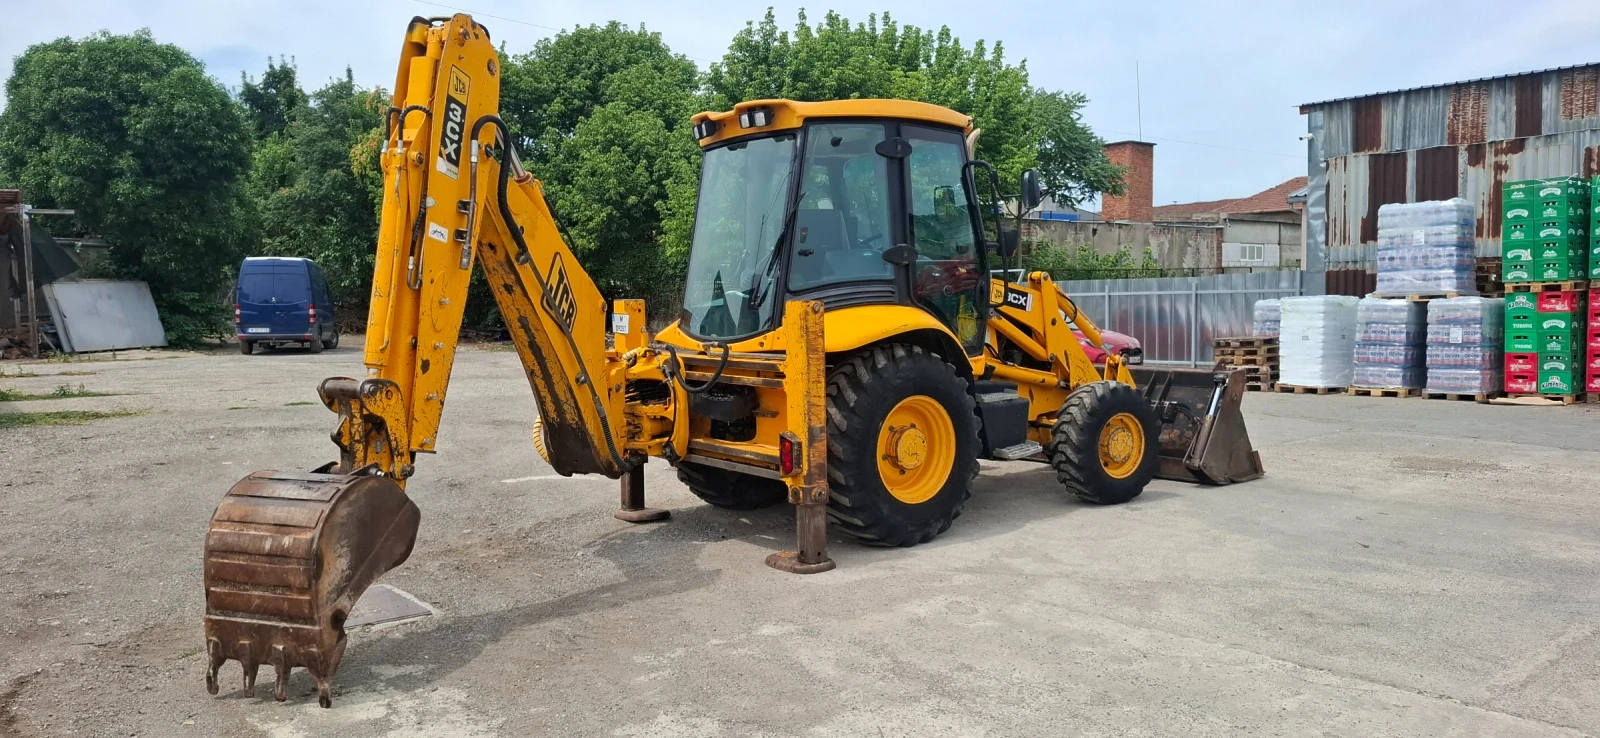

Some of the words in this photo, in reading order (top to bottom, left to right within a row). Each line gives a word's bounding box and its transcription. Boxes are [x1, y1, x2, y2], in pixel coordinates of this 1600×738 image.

[454, 76, 467, 94] JCB
[446, 102, 462, 160] 3CX
[548, 265, 575, 331] JCB
